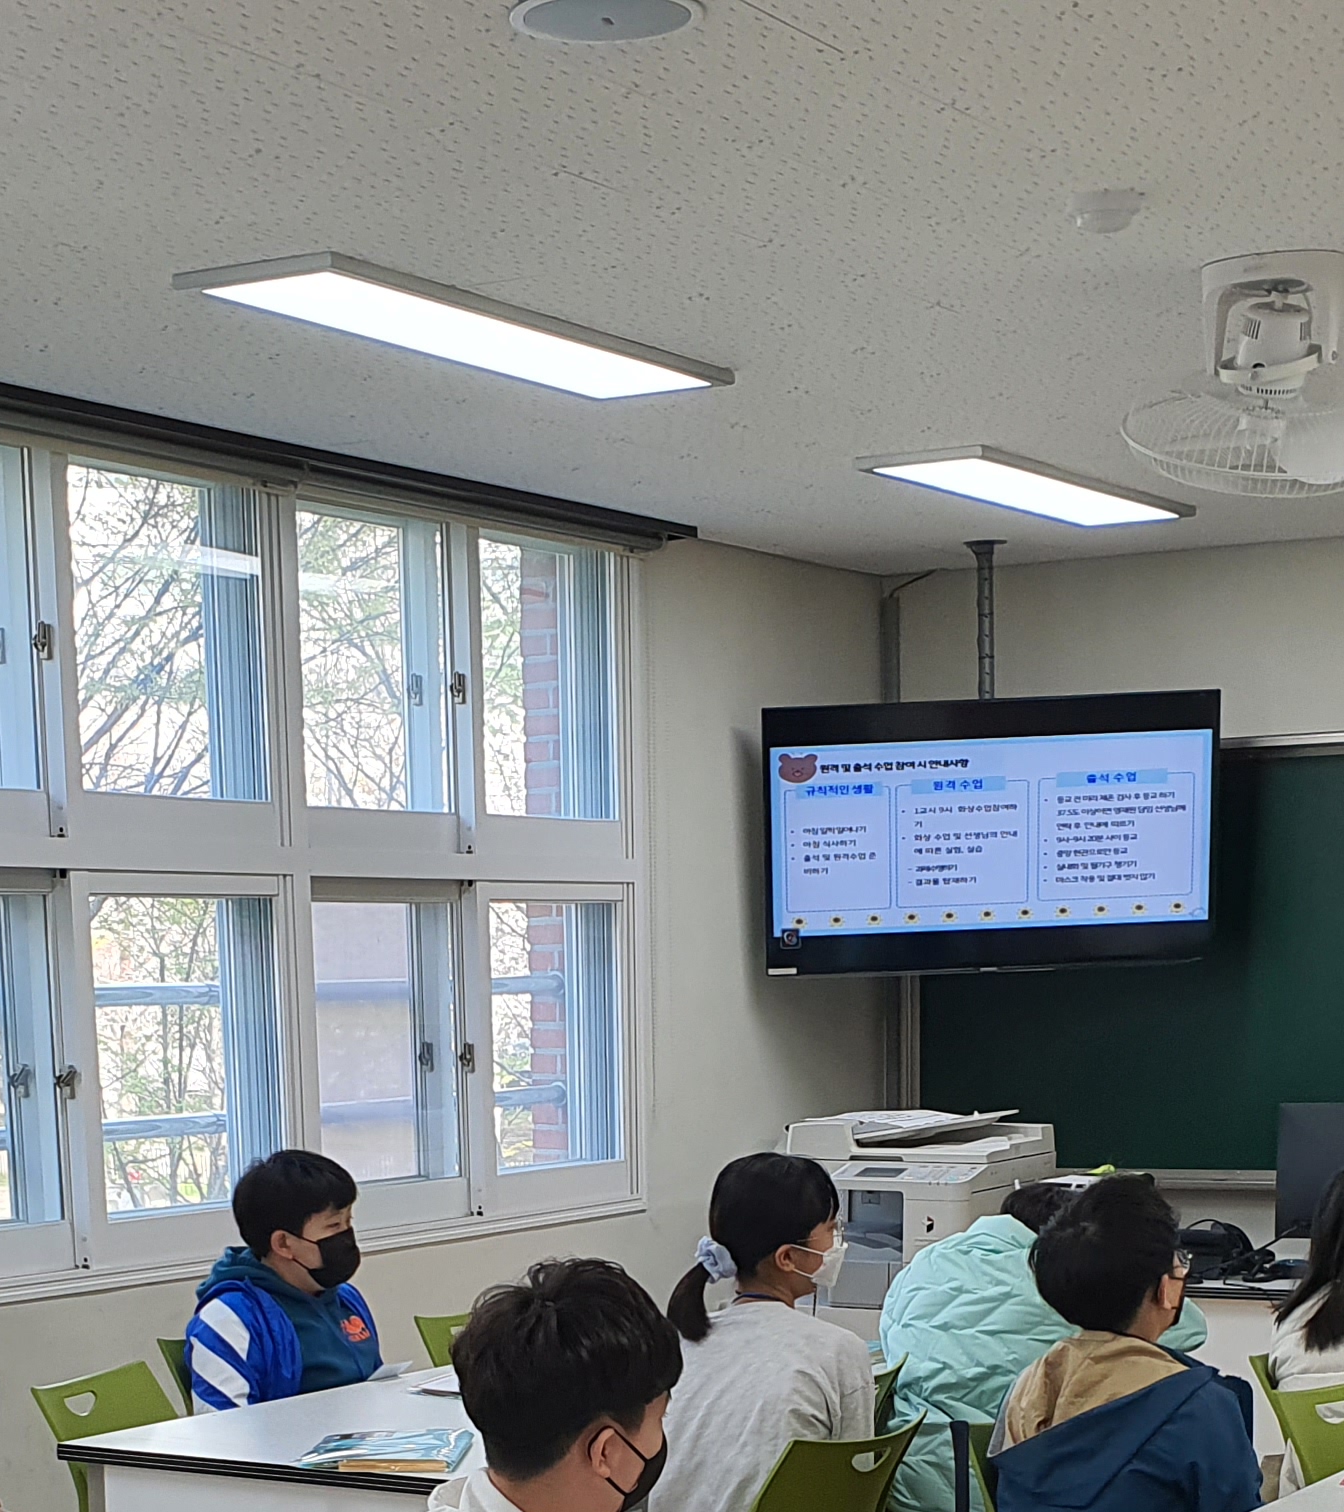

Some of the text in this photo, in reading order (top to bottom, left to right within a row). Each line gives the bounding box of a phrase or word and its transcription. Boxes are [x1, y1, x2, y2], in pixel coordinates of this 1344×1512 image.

[874, 762, 894, 771] 수업
[917, 760, 927, 769] 시
[1113, 771, 1137, 782] 수업
[960, 778, 983, 790] 수업
[806, 784, 874, 796] 규칙적인 생활
